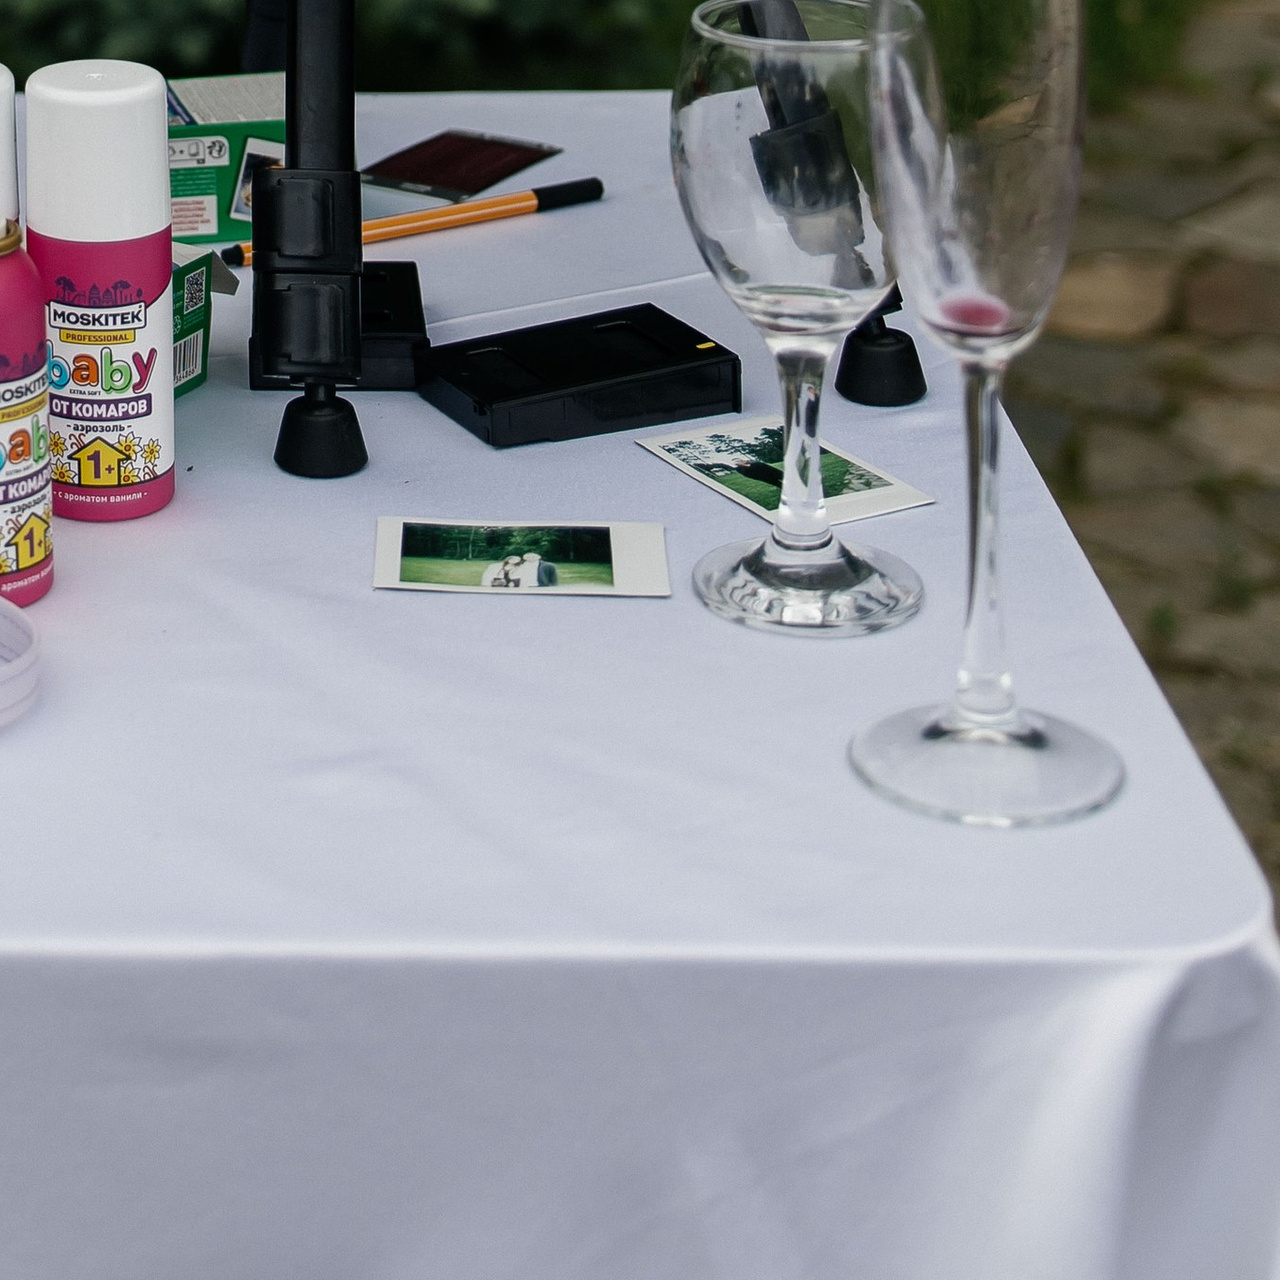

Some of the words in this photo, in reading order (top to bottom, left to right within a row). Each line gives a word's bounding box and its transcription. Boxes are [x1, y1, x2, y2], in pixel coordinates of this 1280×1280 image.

[53, 305, 142, 327] MOSKITEK
[66, 332, 129, 343] PROFESSIONAL
[46, 338, 158, 395] baby
[52, 399, 69, 414] ОТ
[72, 399, 148, 418] КОМАРОВ
[73, 423, 125, 434] аэрозоль
[87, 450, 115, 479] 1+
[64, 492, 108, 503] ароматом
[110, 492, 142, 503] ванили
